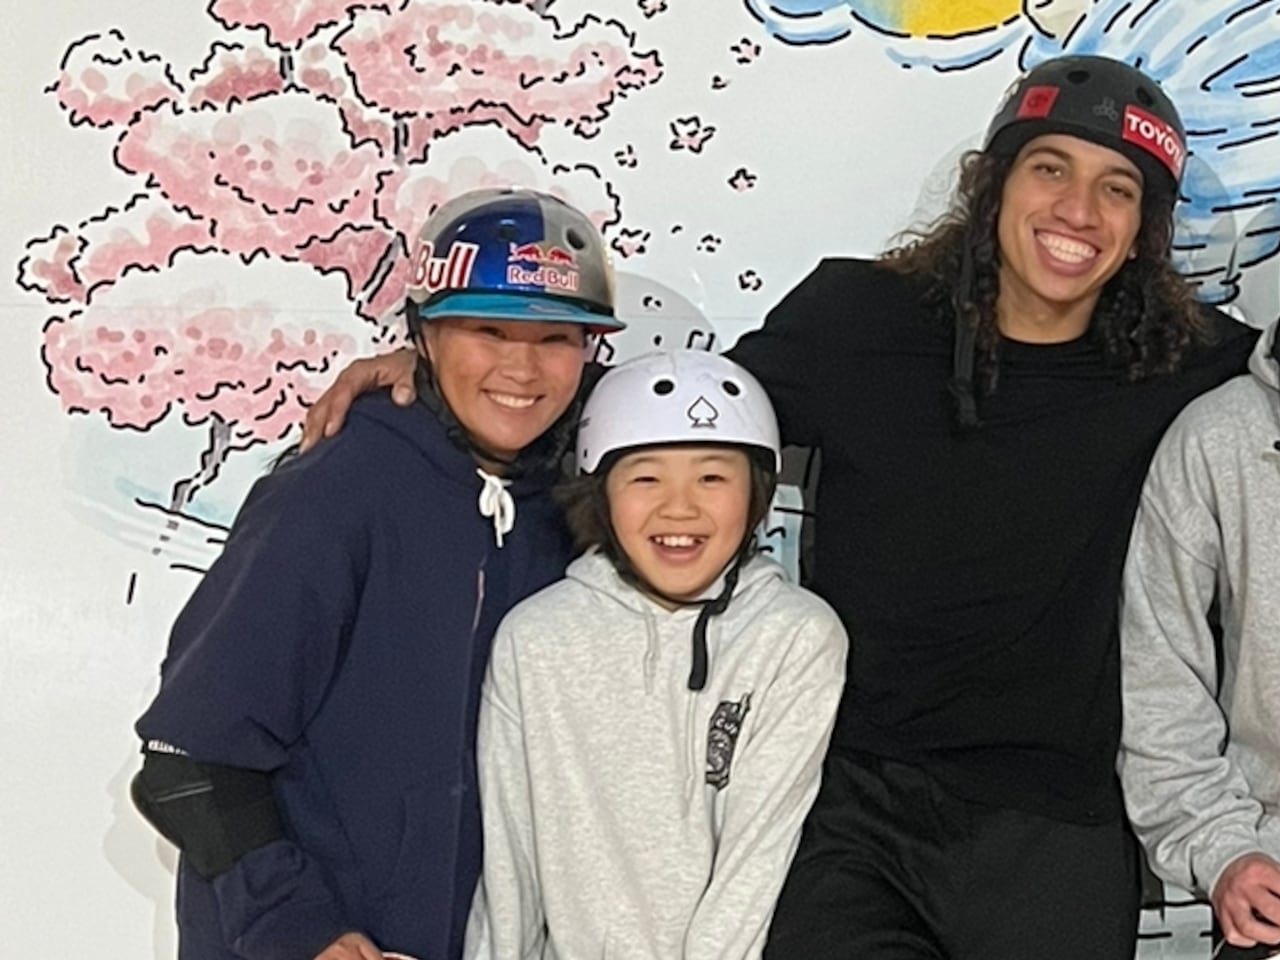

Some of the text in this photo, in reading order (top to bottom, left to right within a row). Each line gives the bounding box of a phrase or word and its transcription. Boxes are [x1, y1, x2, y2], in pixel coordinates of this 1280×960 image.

[414, 241, 478, 293] Bull
[508, 266, 579, 289] Red Bull
